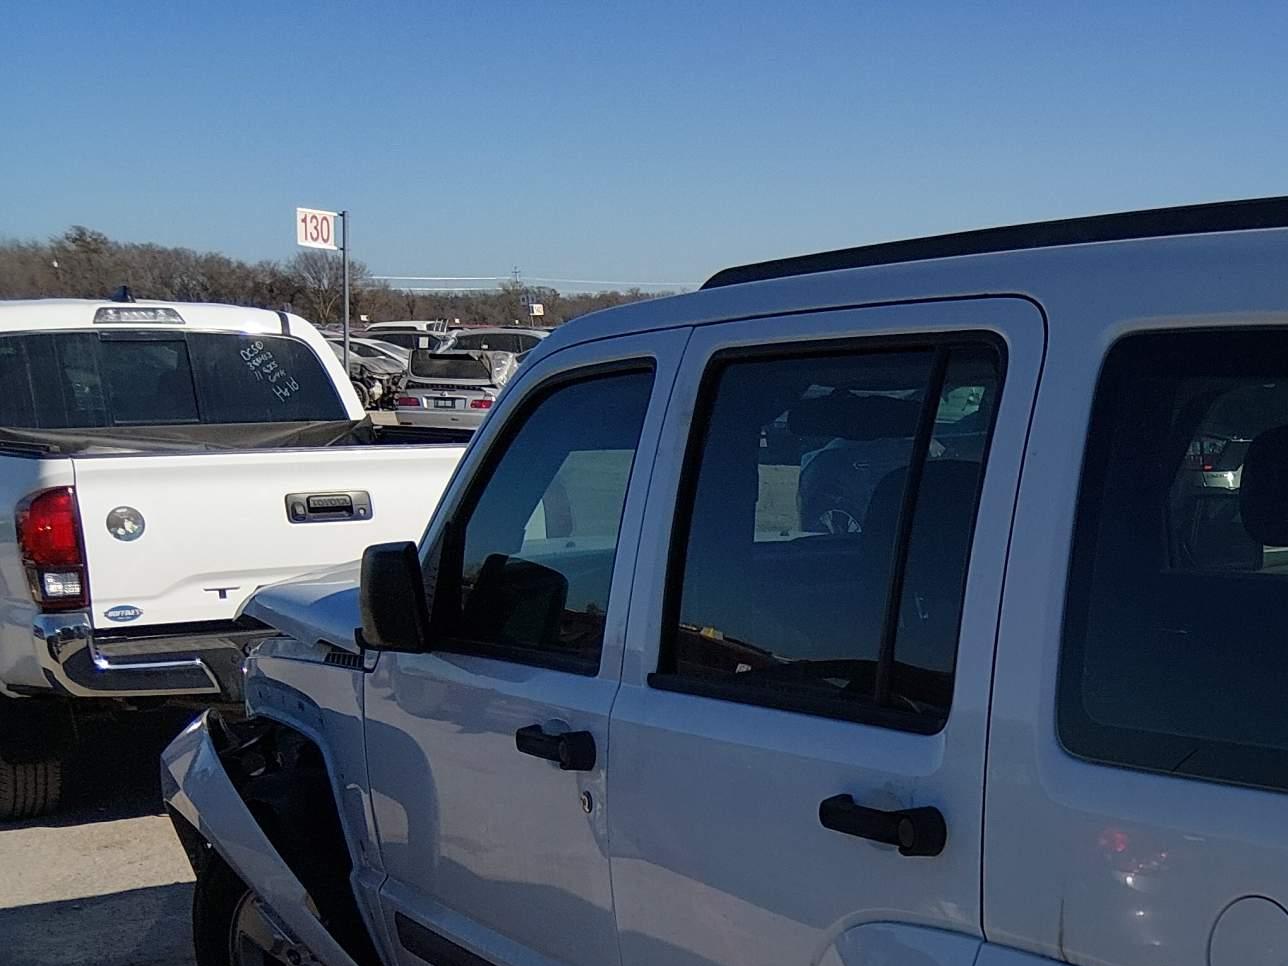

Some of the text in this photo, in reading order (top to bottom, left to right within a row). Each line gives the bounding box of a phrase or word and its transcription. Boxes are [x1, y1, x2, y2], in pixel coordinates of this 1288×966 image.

[301, 213, 330, 243] 130
[272, 376, 299, 402] Hold
[311, 498, 350, 507] TOYOTA
